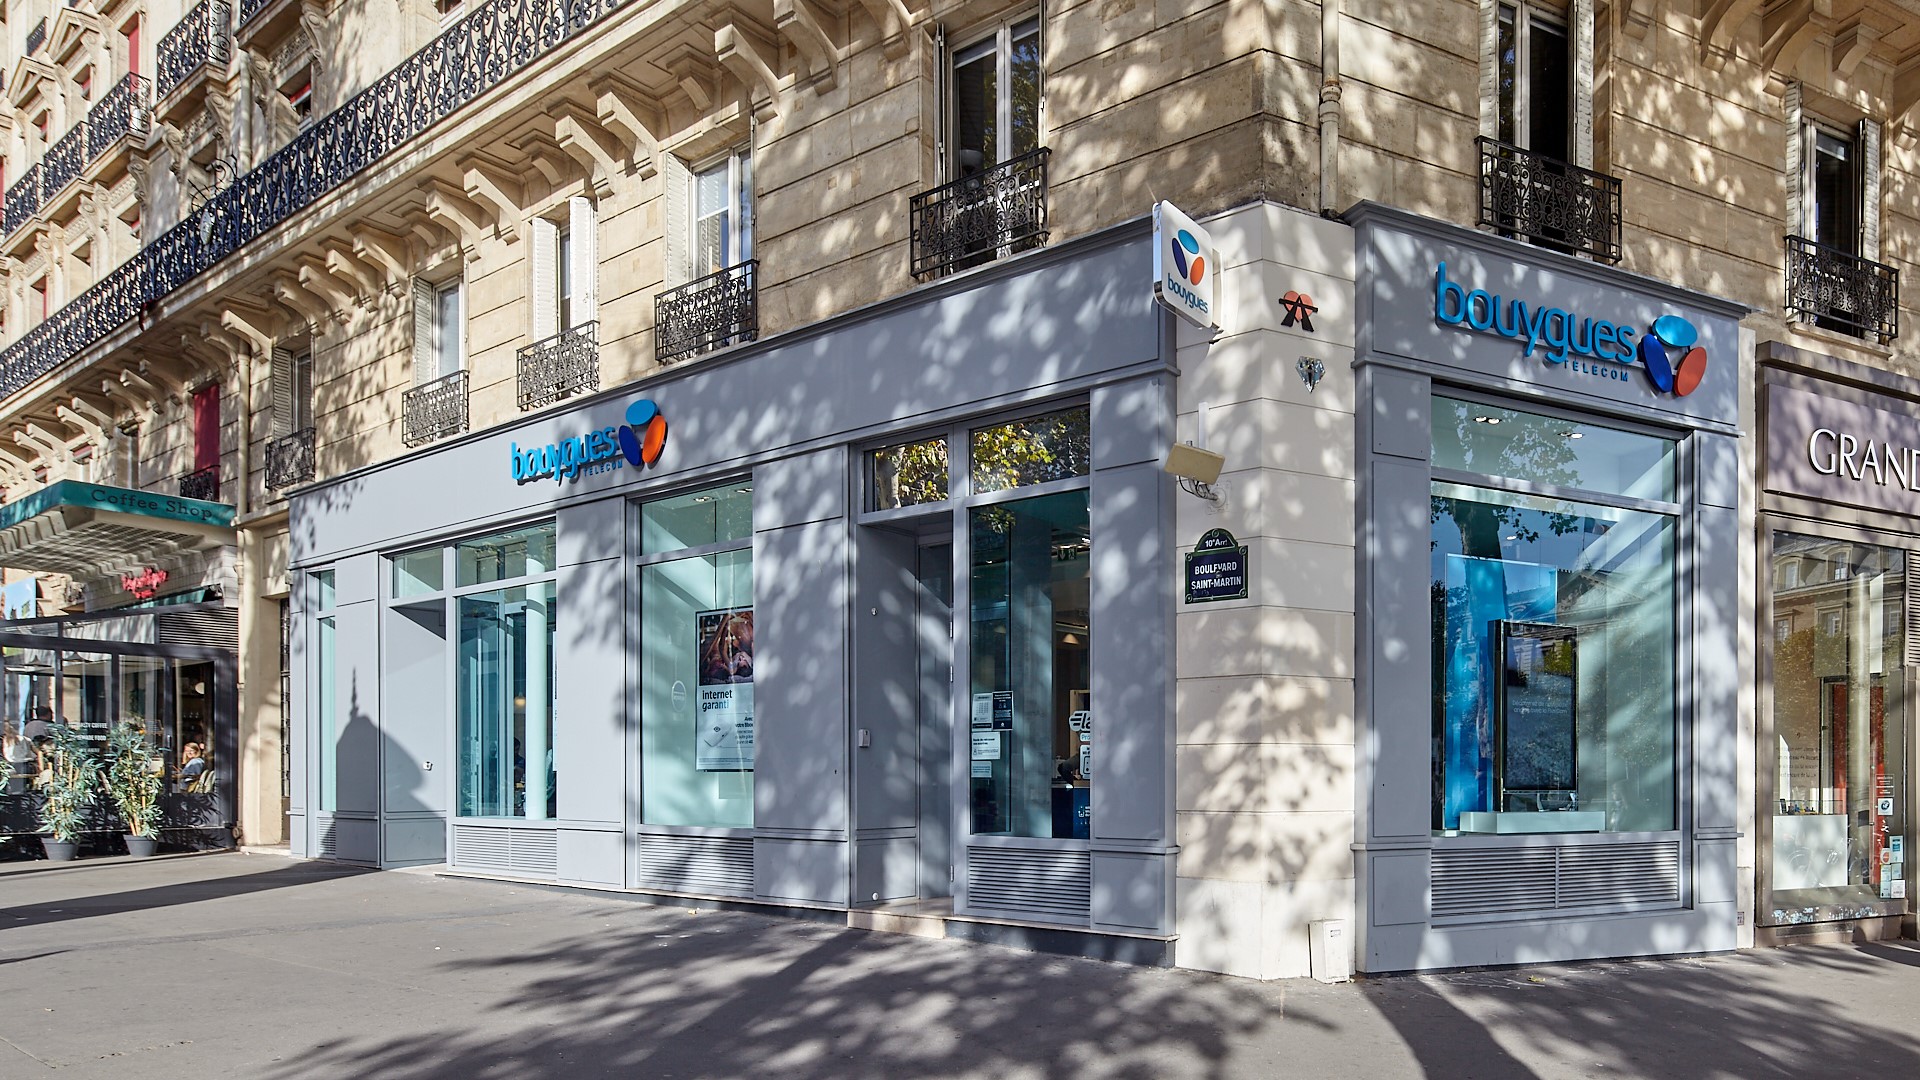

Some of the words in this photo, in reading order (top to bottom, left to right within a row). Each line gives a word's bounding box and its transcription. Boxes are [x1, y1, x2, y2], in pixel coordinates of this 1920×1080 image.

[1168, 272, 1208, 314] bouygues
[1436, 261, 1637, 364] bouygues
[1564, 359, 1629, 382] TELECOM
[511, 426, 618, 482] bouygues
[583, 460, 624, 477] TELECOM
[91, 489, 158, 510] Coffee
[165, 500, 213, 520] Shop
[1194, 561, 1238, 575] BOULEVARD
[1191, 575, 1242, 590] SAINT-MARTIN
[702, 689, 733, 700] internet
[702, 700, 730, 712] garanti
